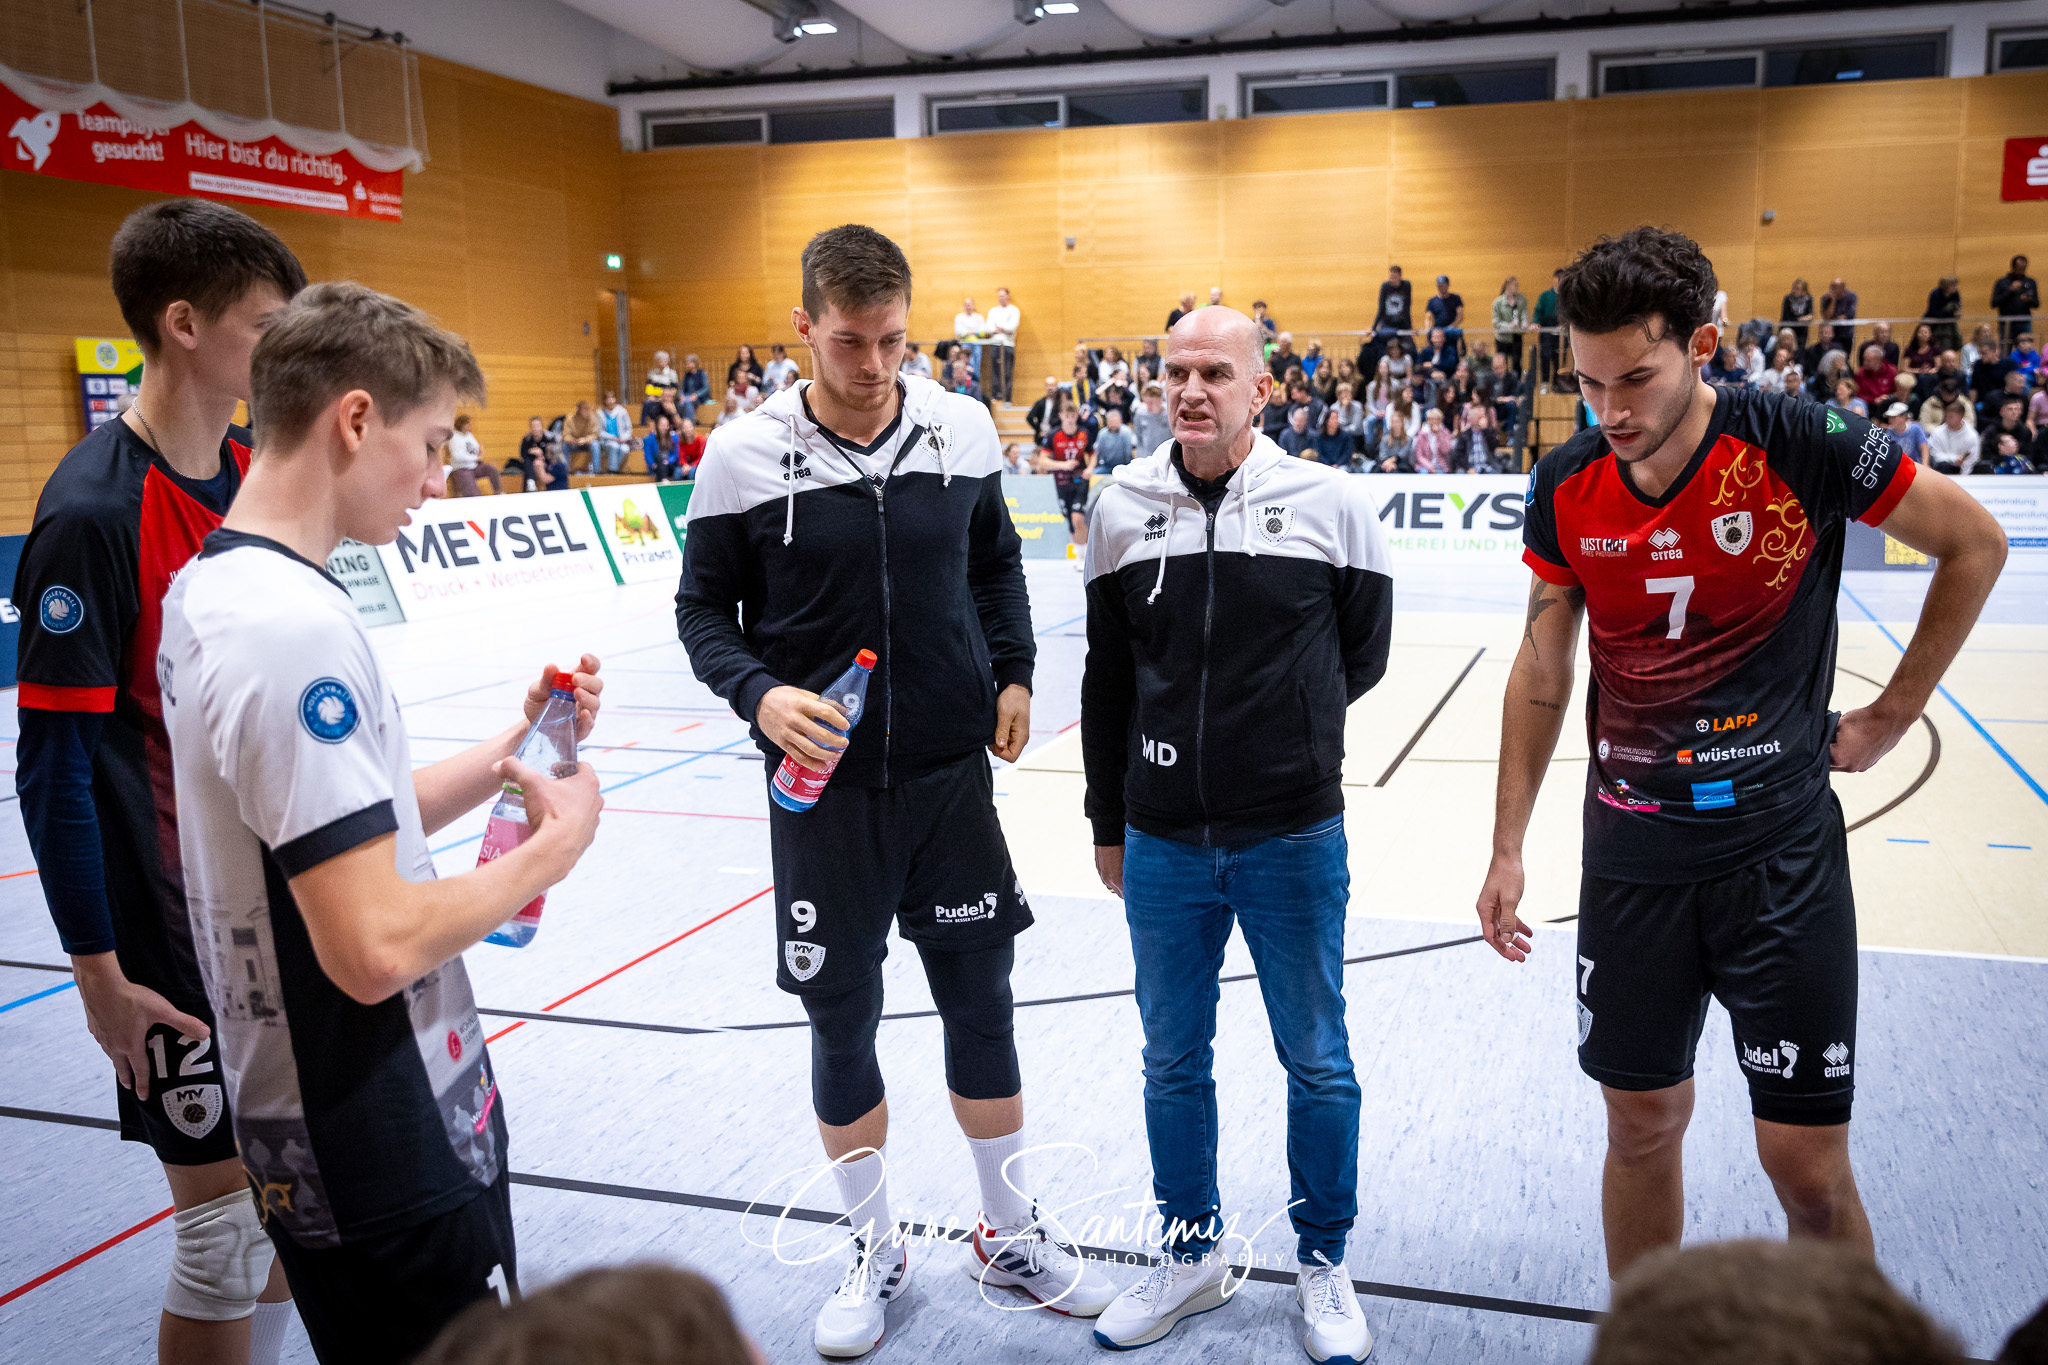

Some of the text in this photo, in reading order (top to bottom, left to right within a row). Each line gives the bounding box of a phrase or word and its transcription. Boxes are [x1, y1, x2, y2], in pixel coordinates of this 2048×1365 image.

[92, 139, 164, 163] gesucht!
[185, 131, 348, 185] Hier bist du richtig.
[1265, 507, 1286, 516] MTV
[1722, 513, 1740, 527] MTV
[397, 512, 588, 574] MEYSEL
[1452, 537, 1497, 551] UND
[1580, 537, 1602, 551] JUST
[1650, 548, 1683, 561] errea
[412, 578, 466, 601] Druck
[487, 558, 596, 589] Werbetechnik
[1645, 576, 1695, 639] 7
[306, 684, 352, 712] VOLLEYBALL
[1712, 712, 1758, 732] LAPP
[1142, 733, 1178, 767] MD
[1611, 753, 1652, 764] LUDWIGSBURG
[1612, 745, 1657, 757] WOHNUNGSBAU
[1696, 739, 1781, 763] wüstenrot
[790, 900, 817, 934] 9
[935, 900, 985, 919] Pudel
[794, 943, 815, 954] MTV
[1578, 954, 1595, 995] 7
[147, 1034, 214, 1079] 12
[1824, 1063, 1850, 1078] errea
[176, 1087, 205, 1102] MTV
